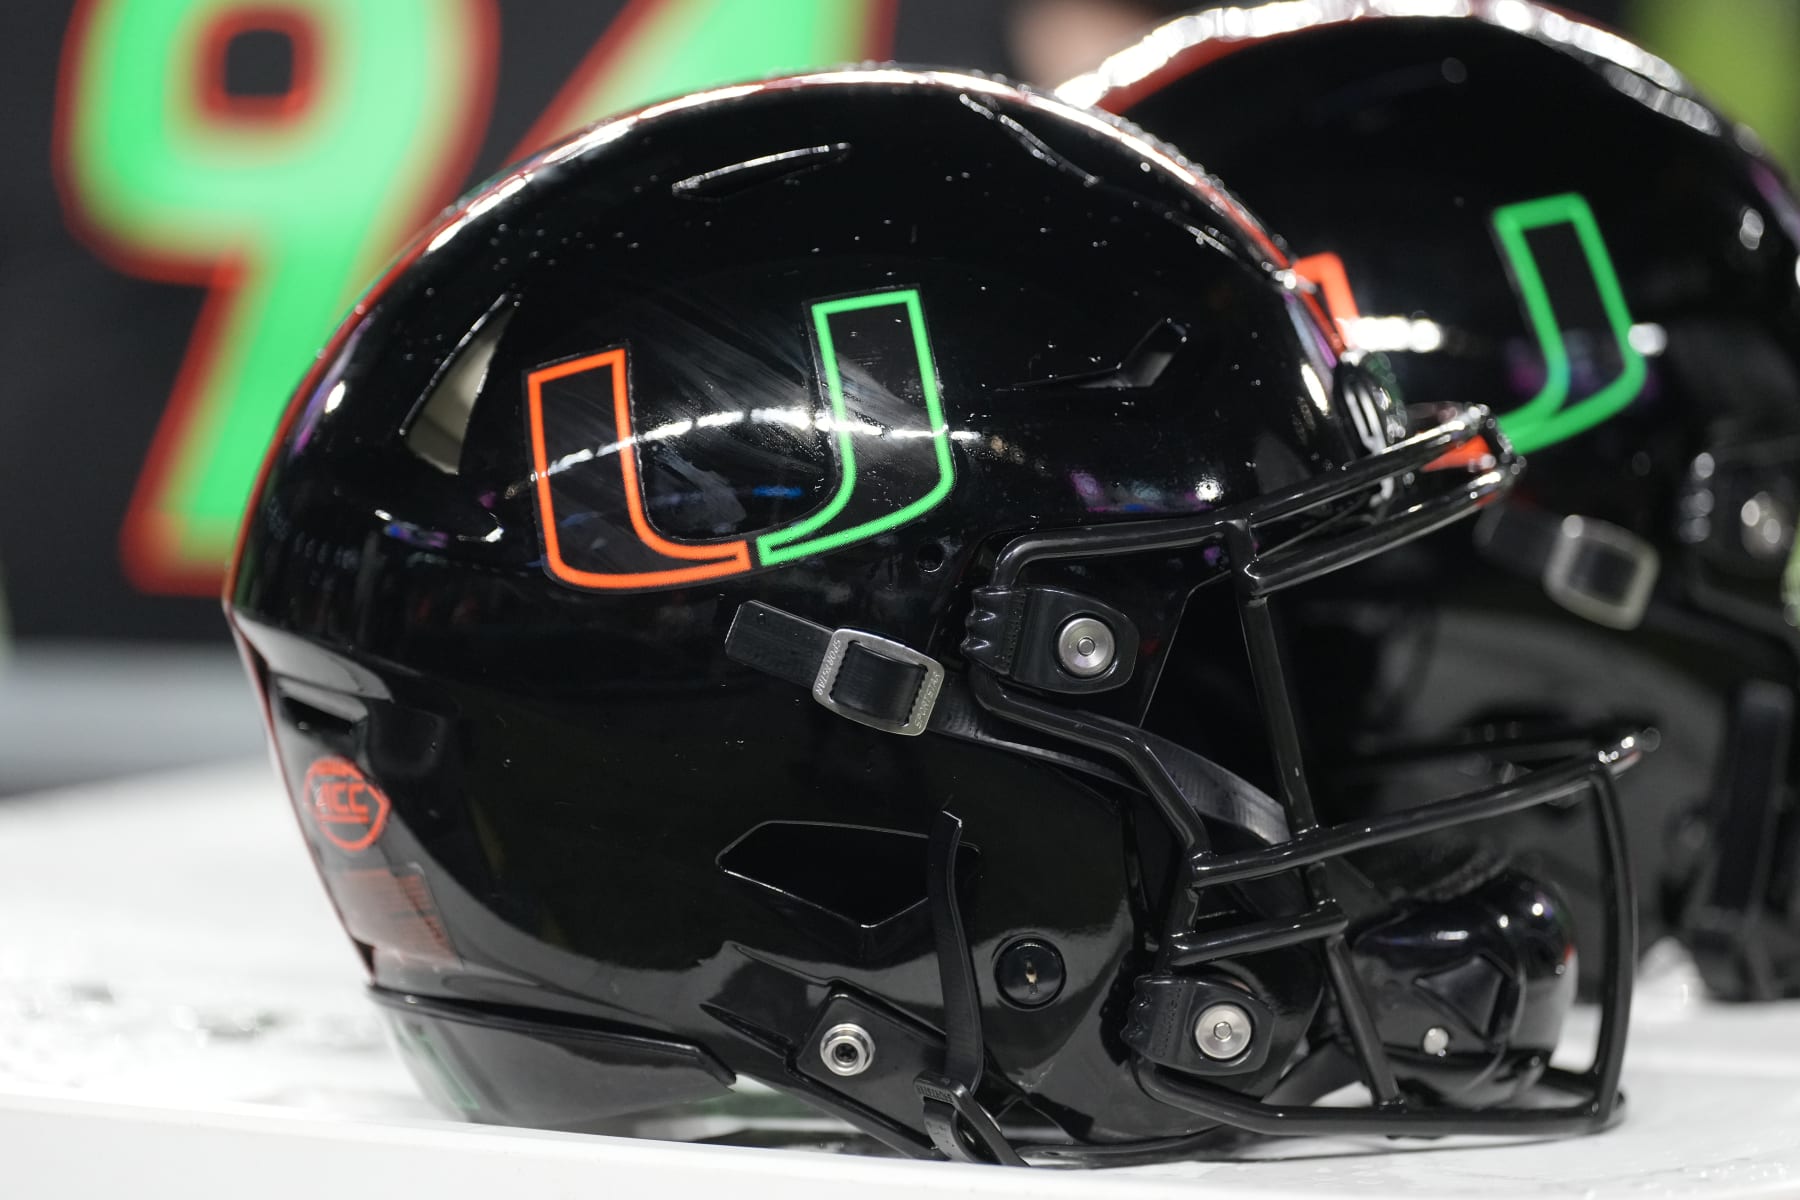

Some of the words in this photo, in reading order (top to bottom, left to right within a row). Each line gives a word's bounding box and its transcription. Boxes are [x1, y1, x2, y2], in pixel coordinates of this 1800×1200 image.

[527, 288, 956, 589] U
[815, 639, 841, 696] SPORTSTAR
[315, 781, 369, 814] ACC
